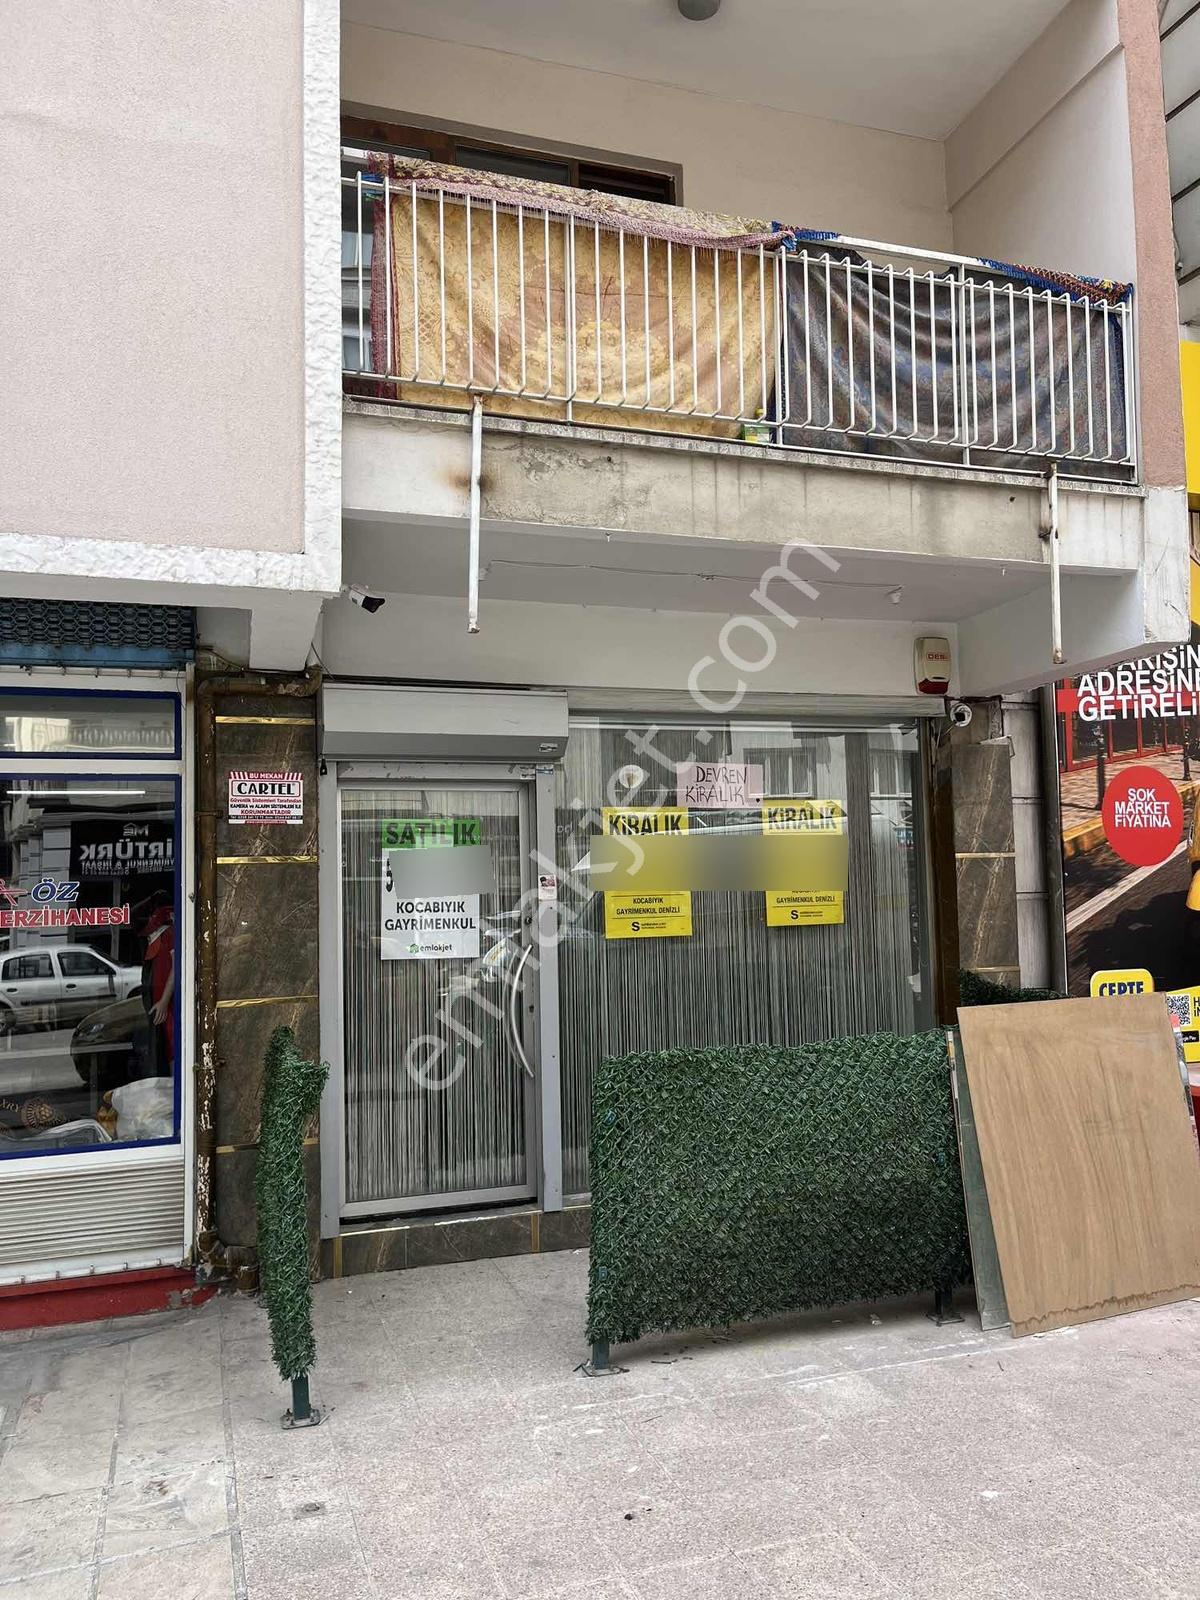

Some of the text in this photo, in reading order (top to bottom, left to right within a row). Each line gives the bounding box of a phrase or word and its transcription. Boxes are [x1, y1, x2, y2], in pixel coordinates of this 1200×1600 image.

[695, 765, 748, 784] DEVREN
[237, 782, 295, 795] CARTEL
[1114, 801, 1170, 815] MARKET
[386, 822, 477, 845] SATILIK
[31, 877, 80, 903] ÖZ
[396, 901, 465, 914] KOCABIYIK
[616, 906, 657, 915] GAYRİMENKUL
[384, 915, 476, 931] GAYRİMENKUL
[419, 943, 453, 953] emlakjet
